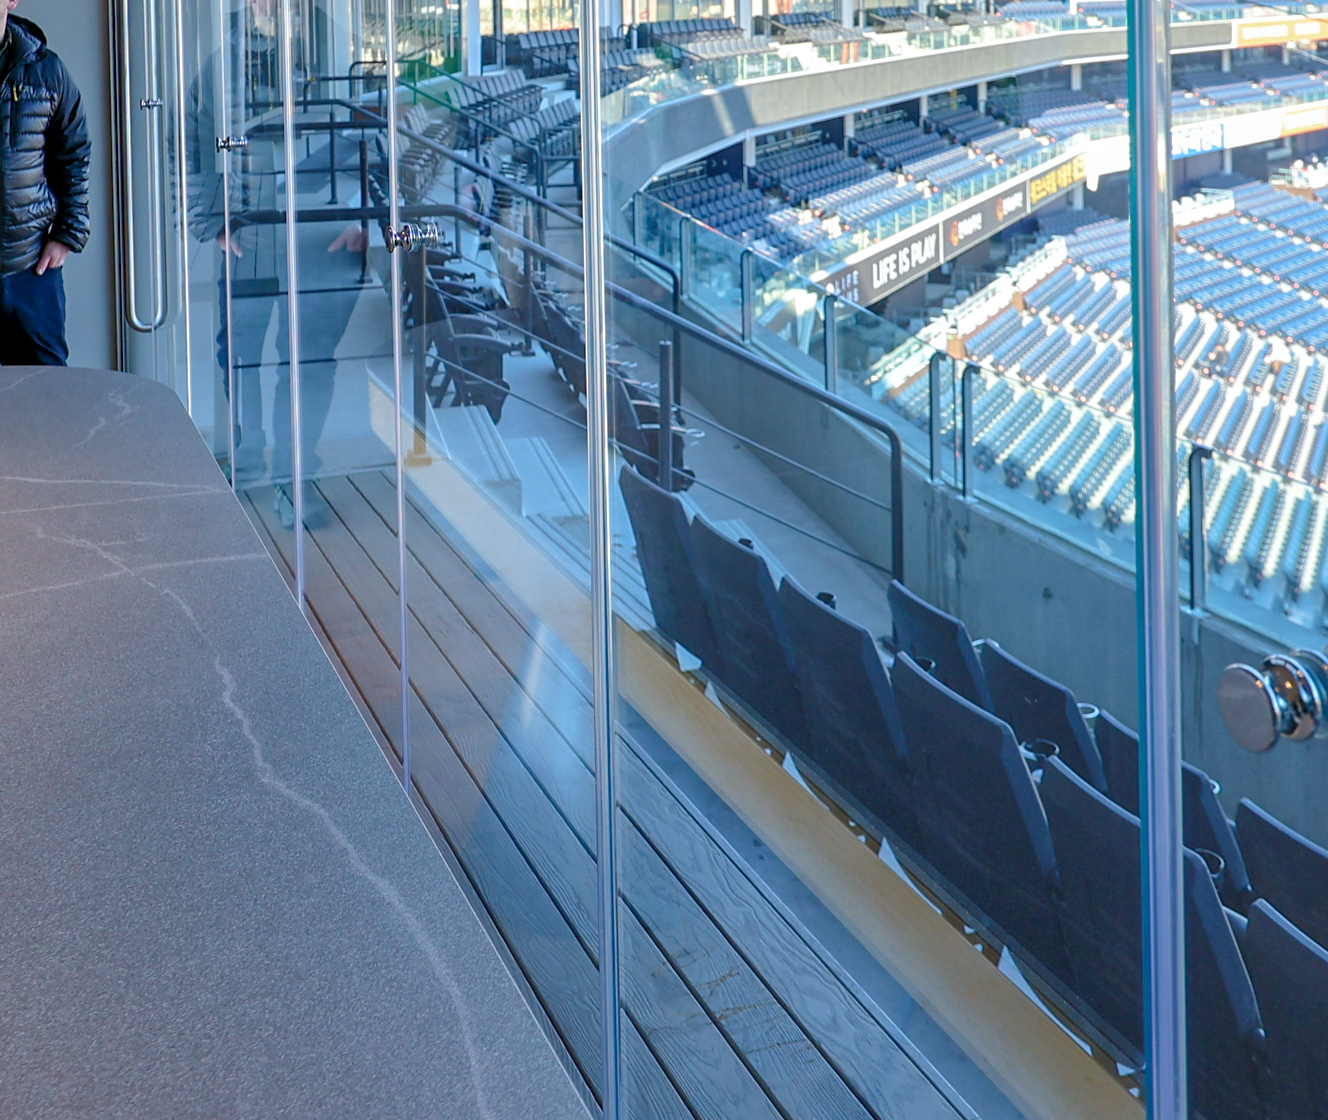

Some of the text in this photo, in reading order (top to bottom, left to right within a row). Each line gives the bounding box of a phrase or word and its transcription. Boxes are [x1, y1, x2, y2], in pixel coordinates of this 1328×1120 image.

[872, 232, 937, 290] LIFE IS PLAY
